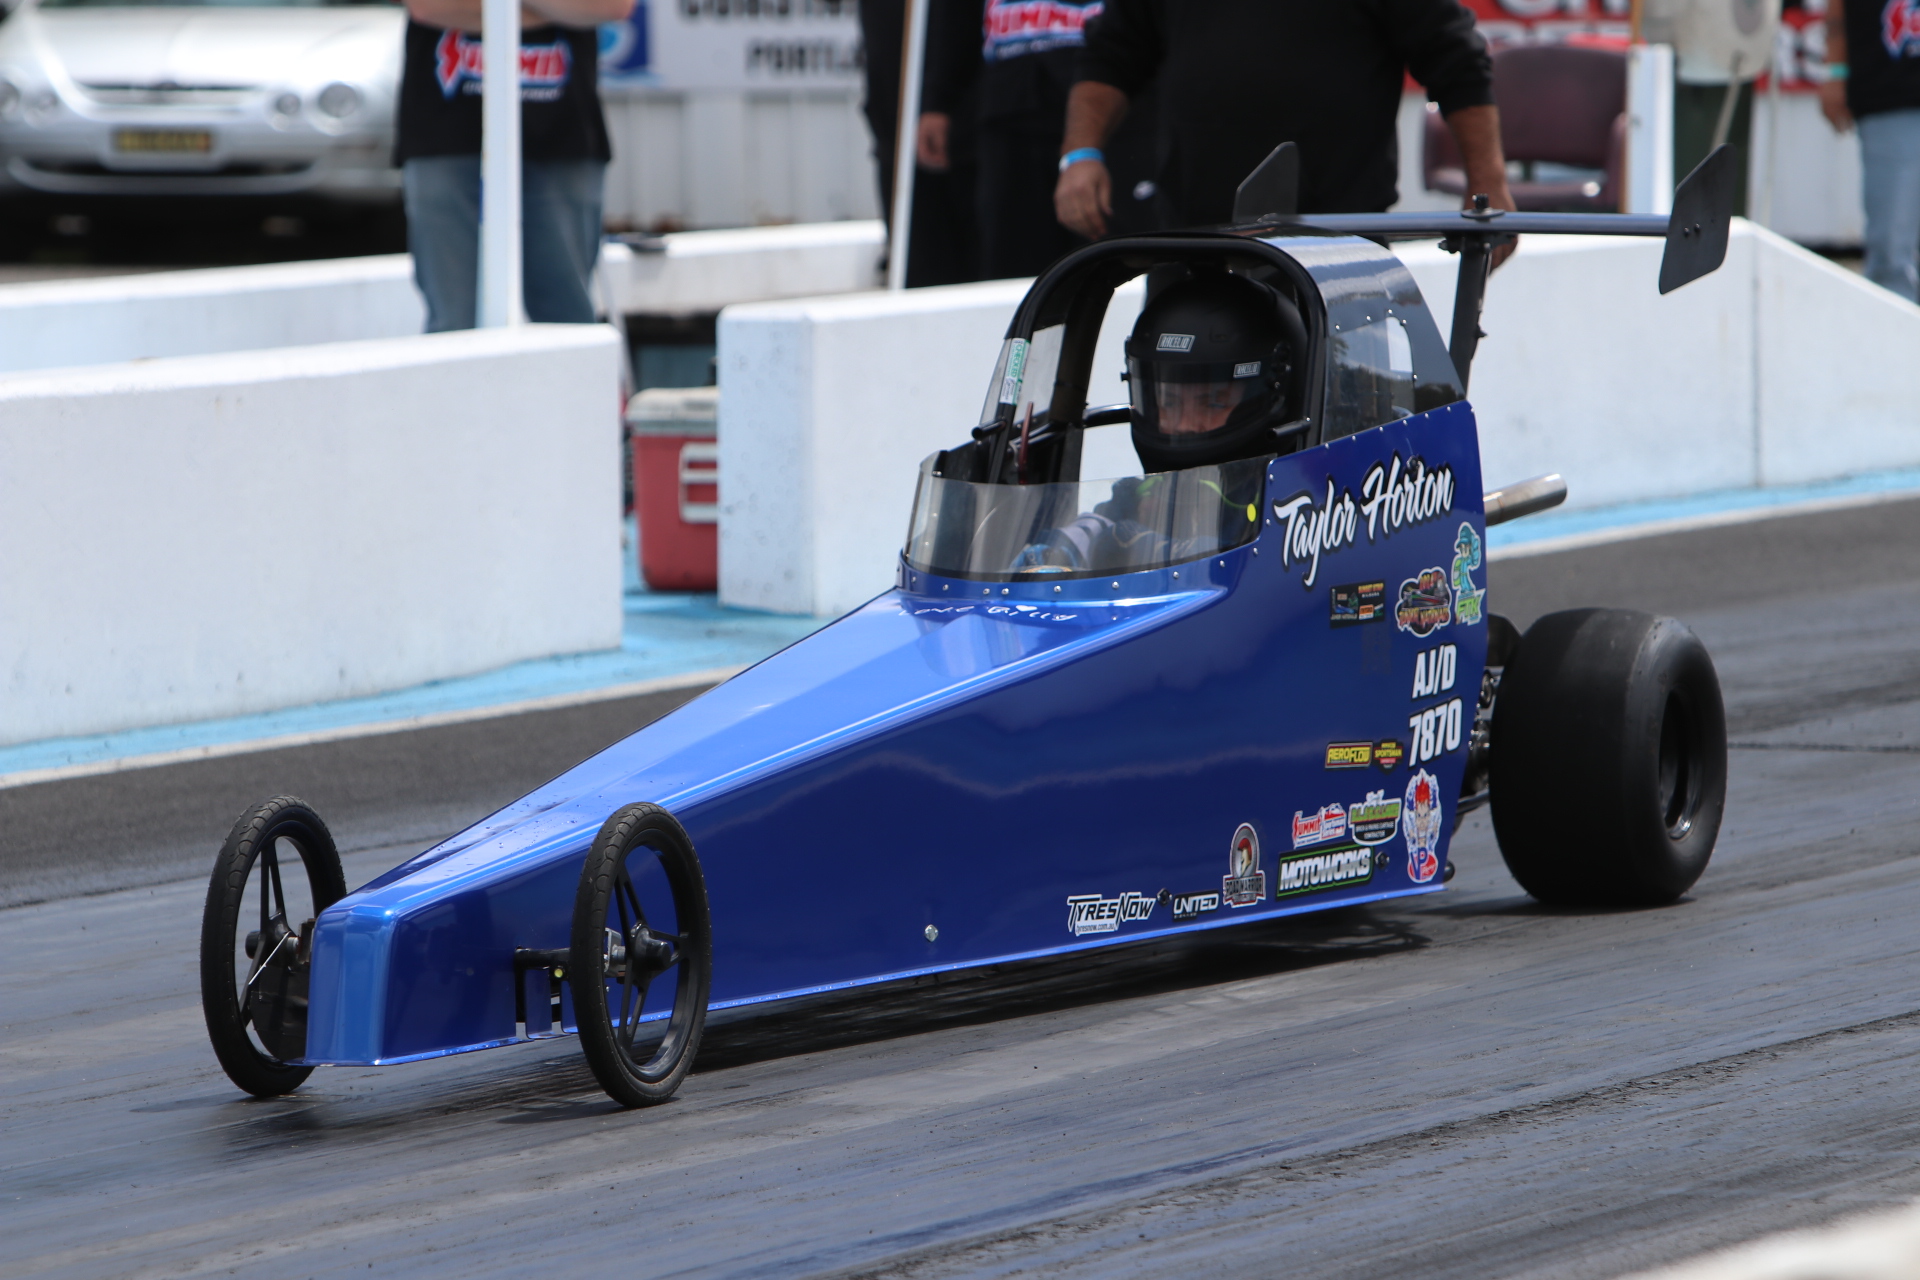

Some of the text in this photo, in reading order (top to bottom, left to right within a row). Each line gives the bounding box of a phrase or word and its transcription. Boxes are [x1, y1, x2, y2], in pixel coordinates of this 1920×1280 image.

[1274, 455, 1455, 586] Taylor Horton
[1457, 594, 1481, 620] FTK
[1412, 644, 1457, 699] AJ/D
[1409, 698, 1462, 767] 7870
[1327, 746, 1371, 765] AEROFLOW
[1374, 749, 1402, 759] SPORTSMAN
[1293, 814, 1322, 840] SUMMIT
[1279, 848, 1371, 891] MOTOWORKS
[1409, 847, 1428, 880] VP
[1173, 893, 1219, 915] UNITED
